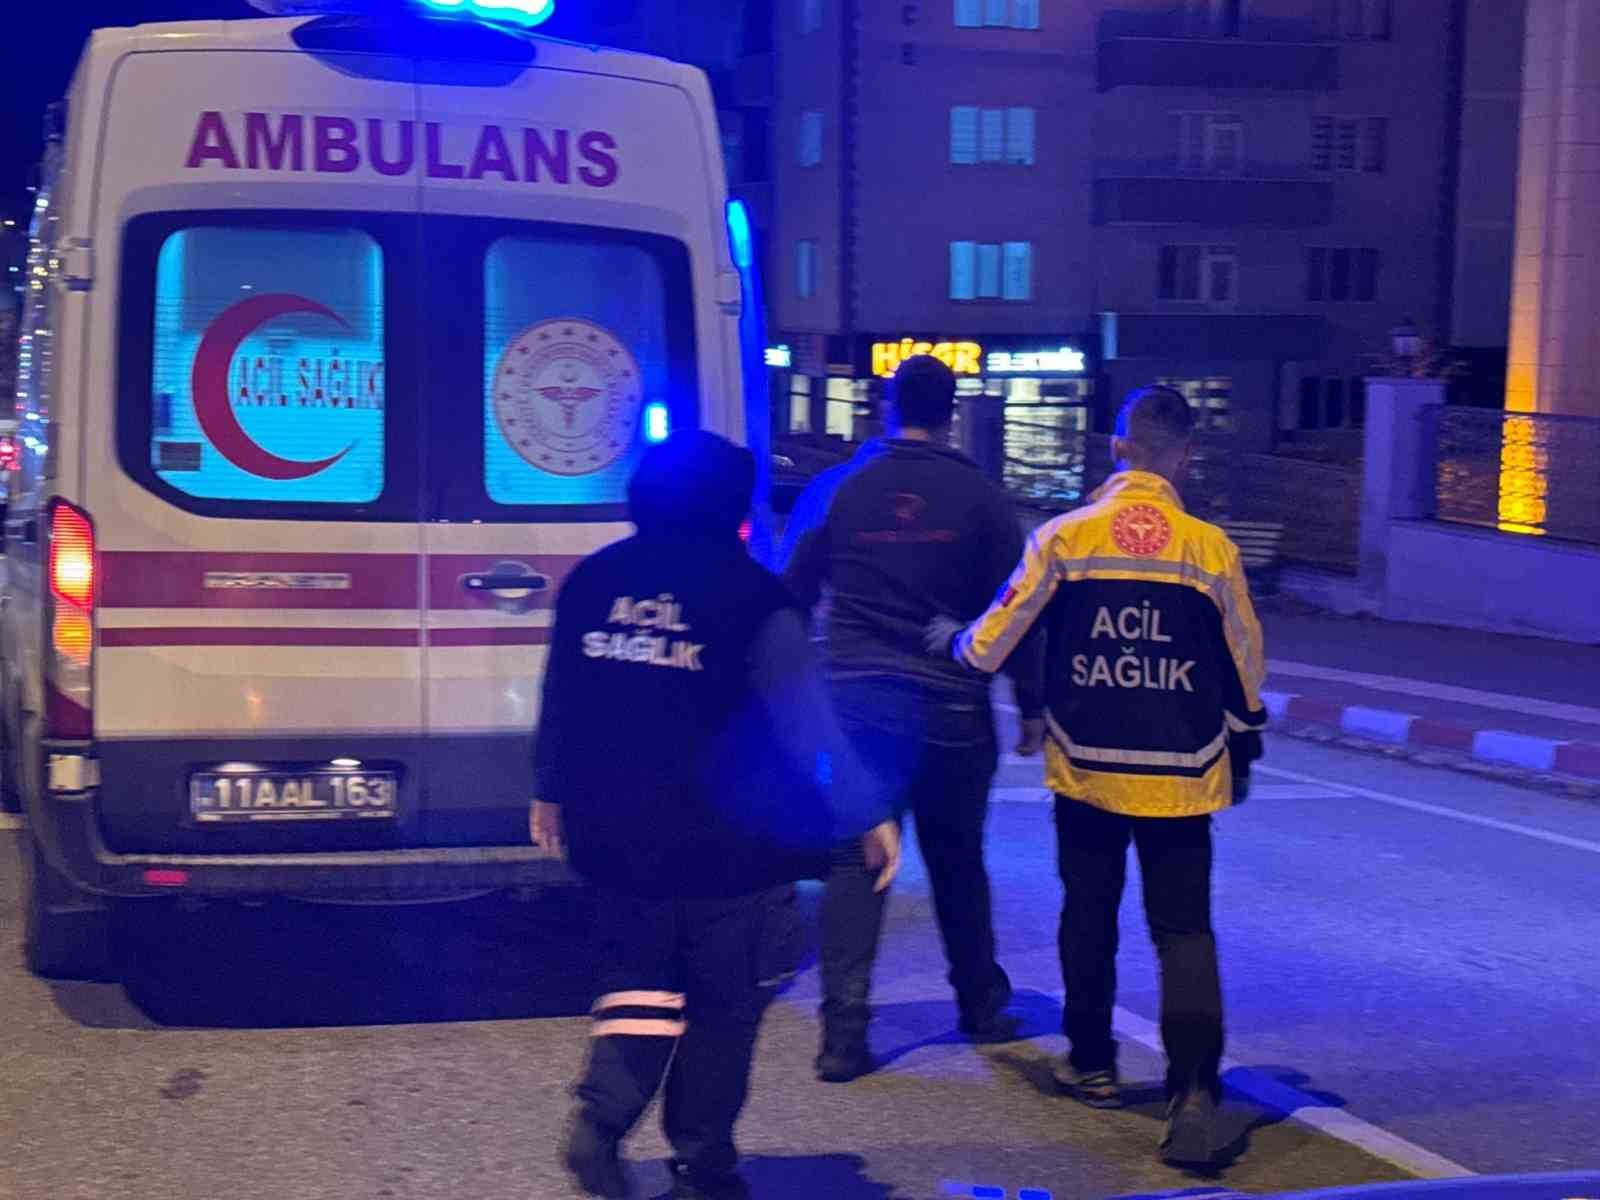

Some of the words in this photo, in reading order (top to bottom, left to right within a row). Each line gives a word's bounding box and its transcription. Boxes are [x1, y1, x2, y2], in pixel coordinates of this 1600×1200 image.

[184, 110, 619, 188] AMBULANS
[607, 592, 690, 631] ACİL
[1090, 600, 1172, 642] ACİL
[582, 629, 705, 671] SAĞLIK
[1071, 646, 1196, 692] SAĞLIK
